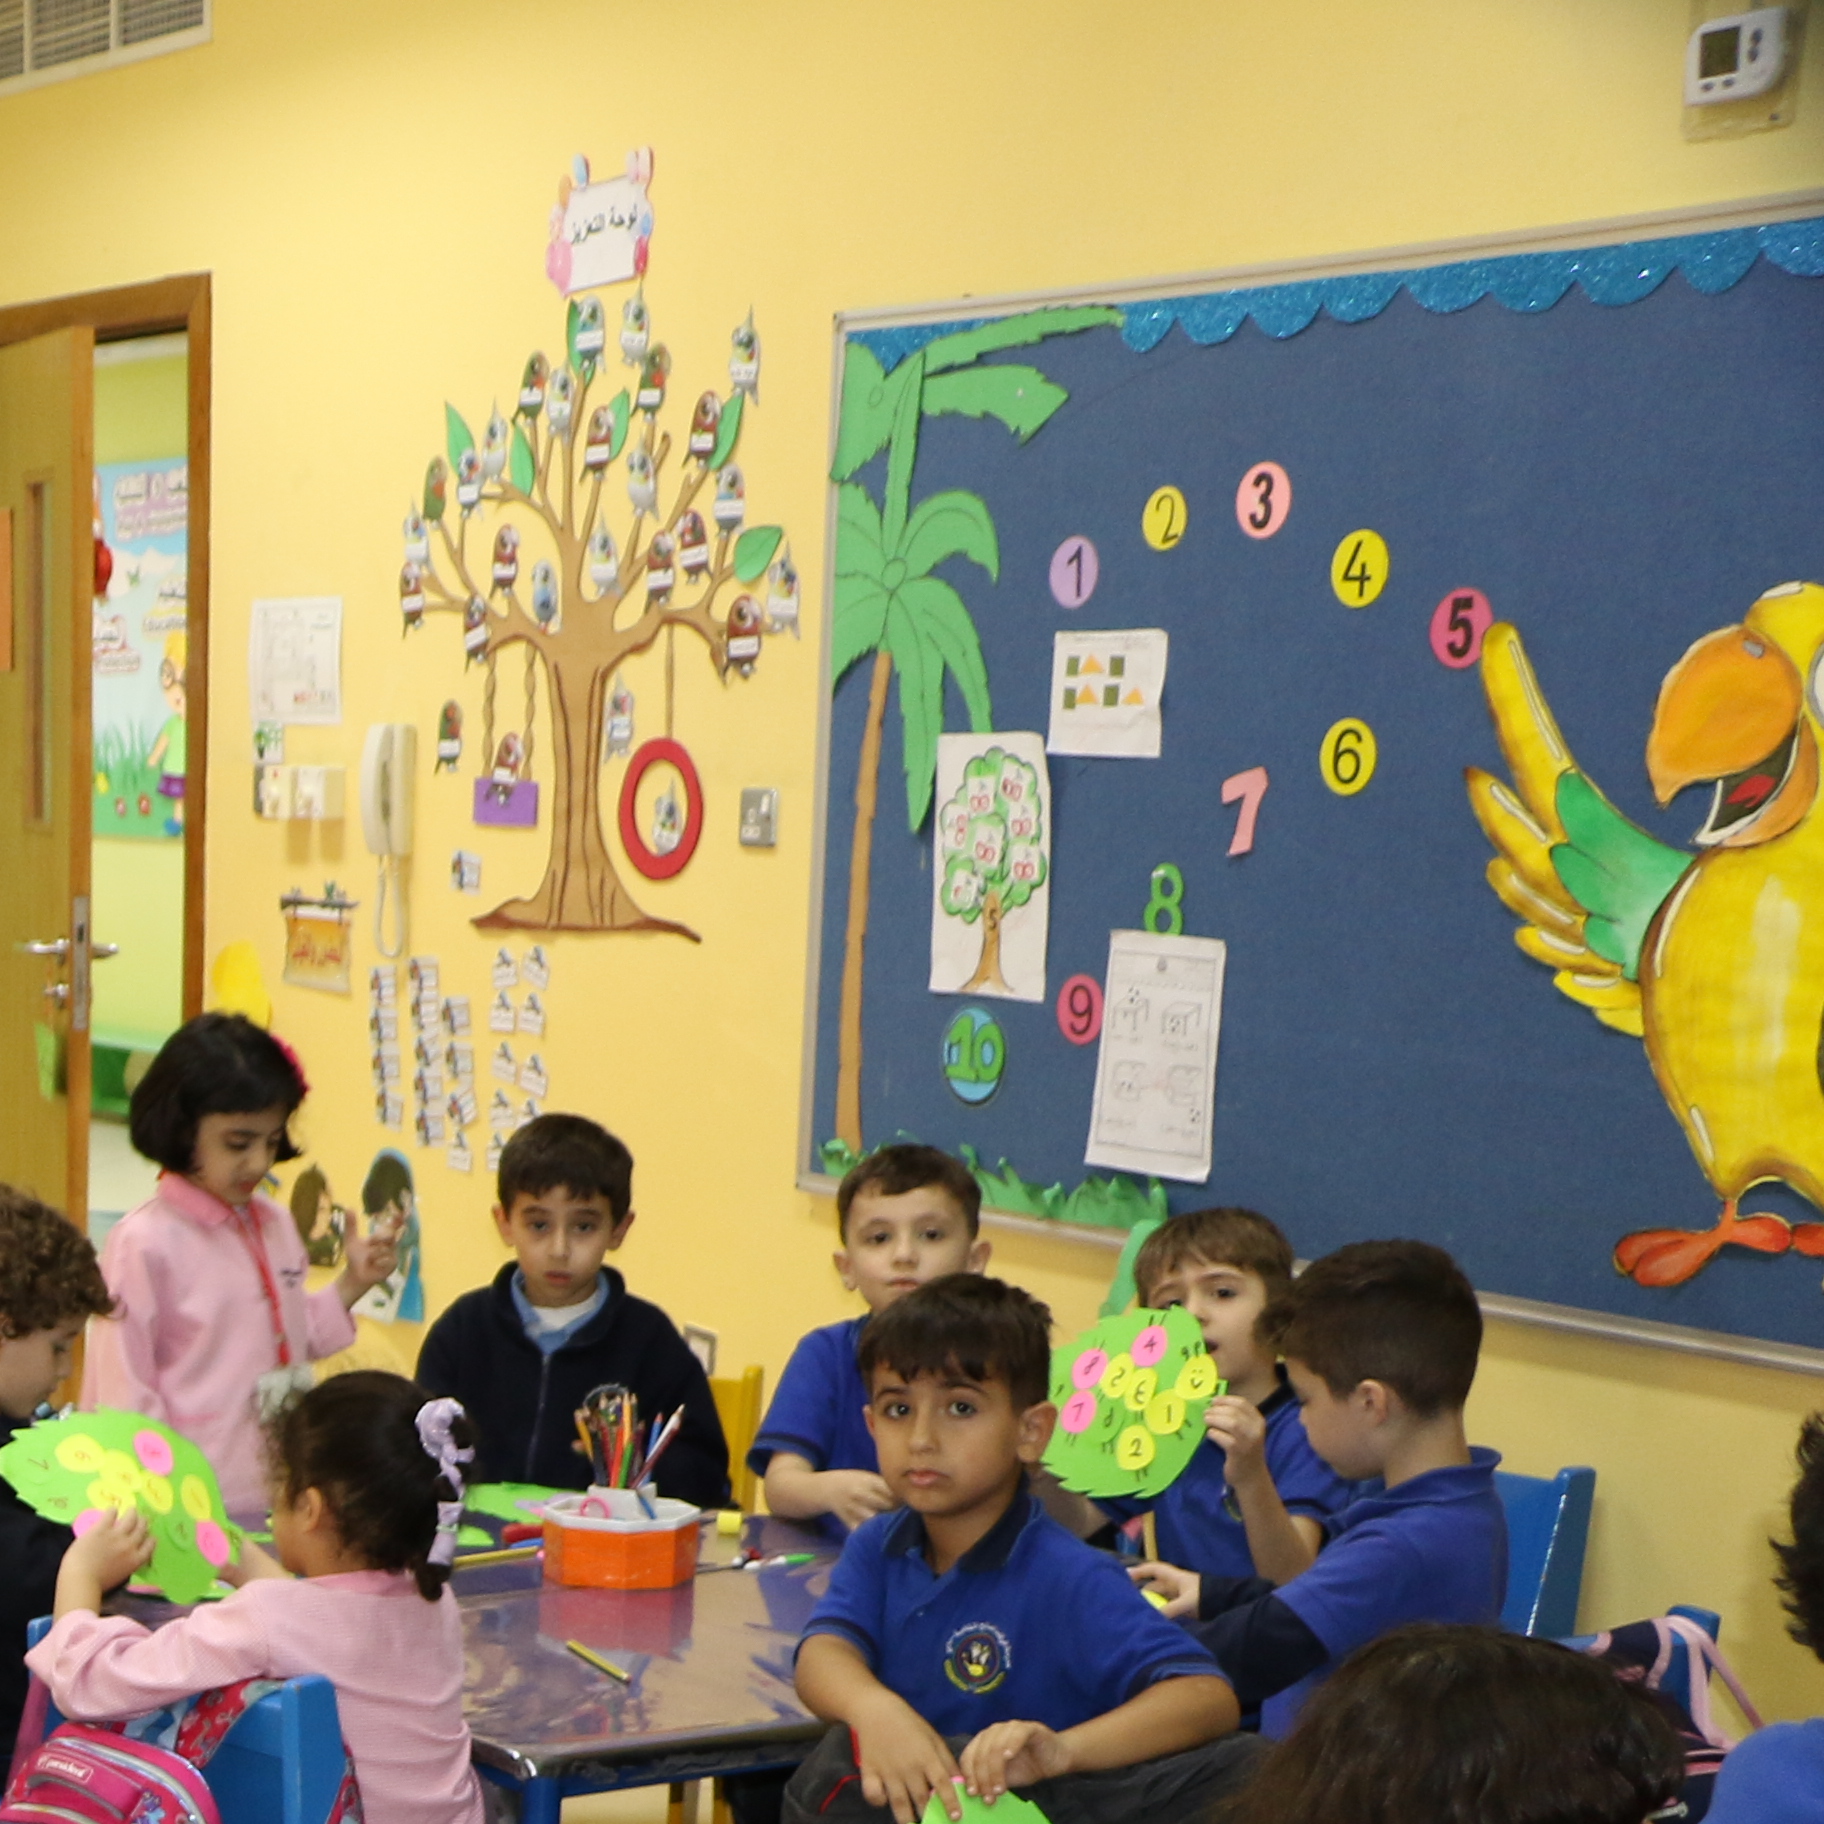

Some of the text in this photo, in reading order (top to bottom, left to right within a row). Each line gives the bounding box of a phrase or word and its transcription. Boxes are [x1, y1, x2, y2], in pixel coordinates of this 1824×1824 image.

[1154, 494, 1178, 544] 2
[1248, 471, 1273, 530] 3
[1065, 543, 1086, 598] 1
[1341, 540, 1370, 598] 4
[1446, 596, 1476, 659] 5
[1333, 726, 1362, 786] 6
[1220, 766, 1269, 858] 7
[1143, 862, 1184, 937] 8
[1070, 981, 1094, 1036] 9
[947, 1012, 1005, 1084] 10
[1072, 1402, 1085, 1423] 7
[1128, 1437, 1143, 1458] 2
